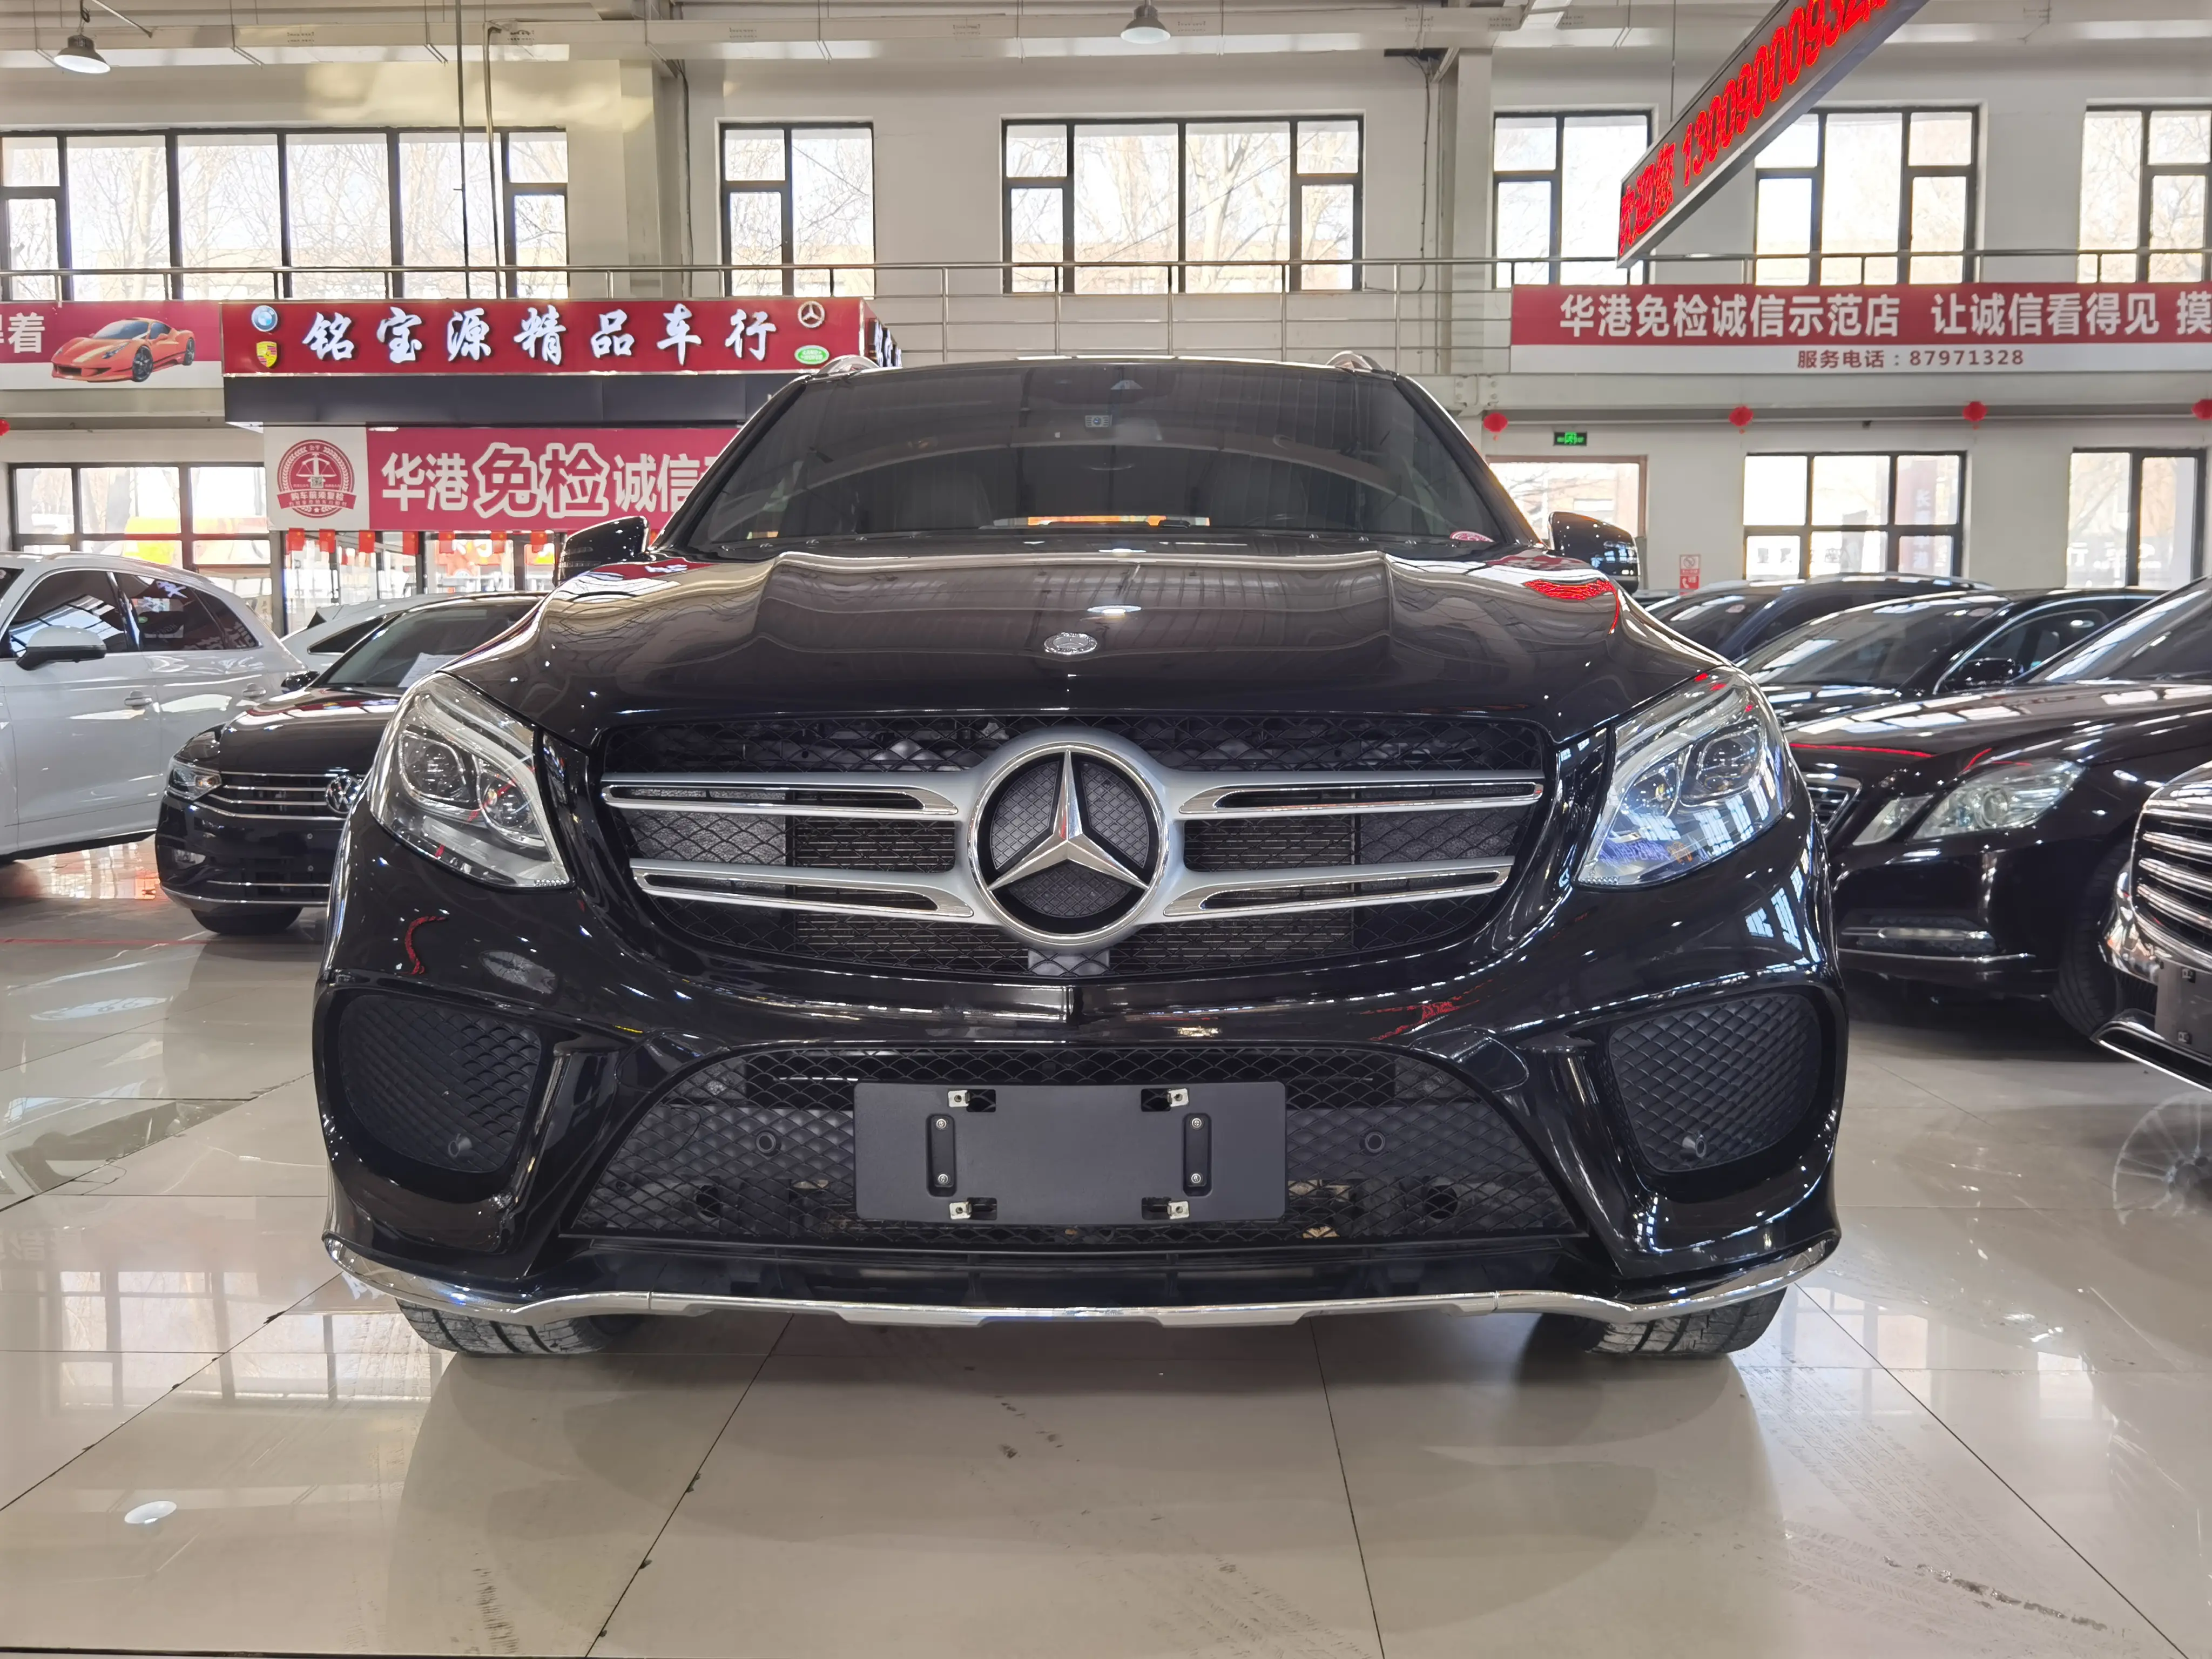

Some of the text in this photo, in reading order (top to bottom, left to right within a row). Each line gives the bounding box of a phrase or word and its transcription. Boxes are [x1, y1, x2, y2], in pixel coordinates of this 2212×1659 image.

[0, 312, 45, 354] 着
[302, 302, 777, 366] 铭宝源精品车行
[1560, 293, 1900, 338] 华港免检诚信示范店
[1931, 292, 2160, 336] 让诚信看得见
[381, 442, 719, 519] 华港免检诚信
